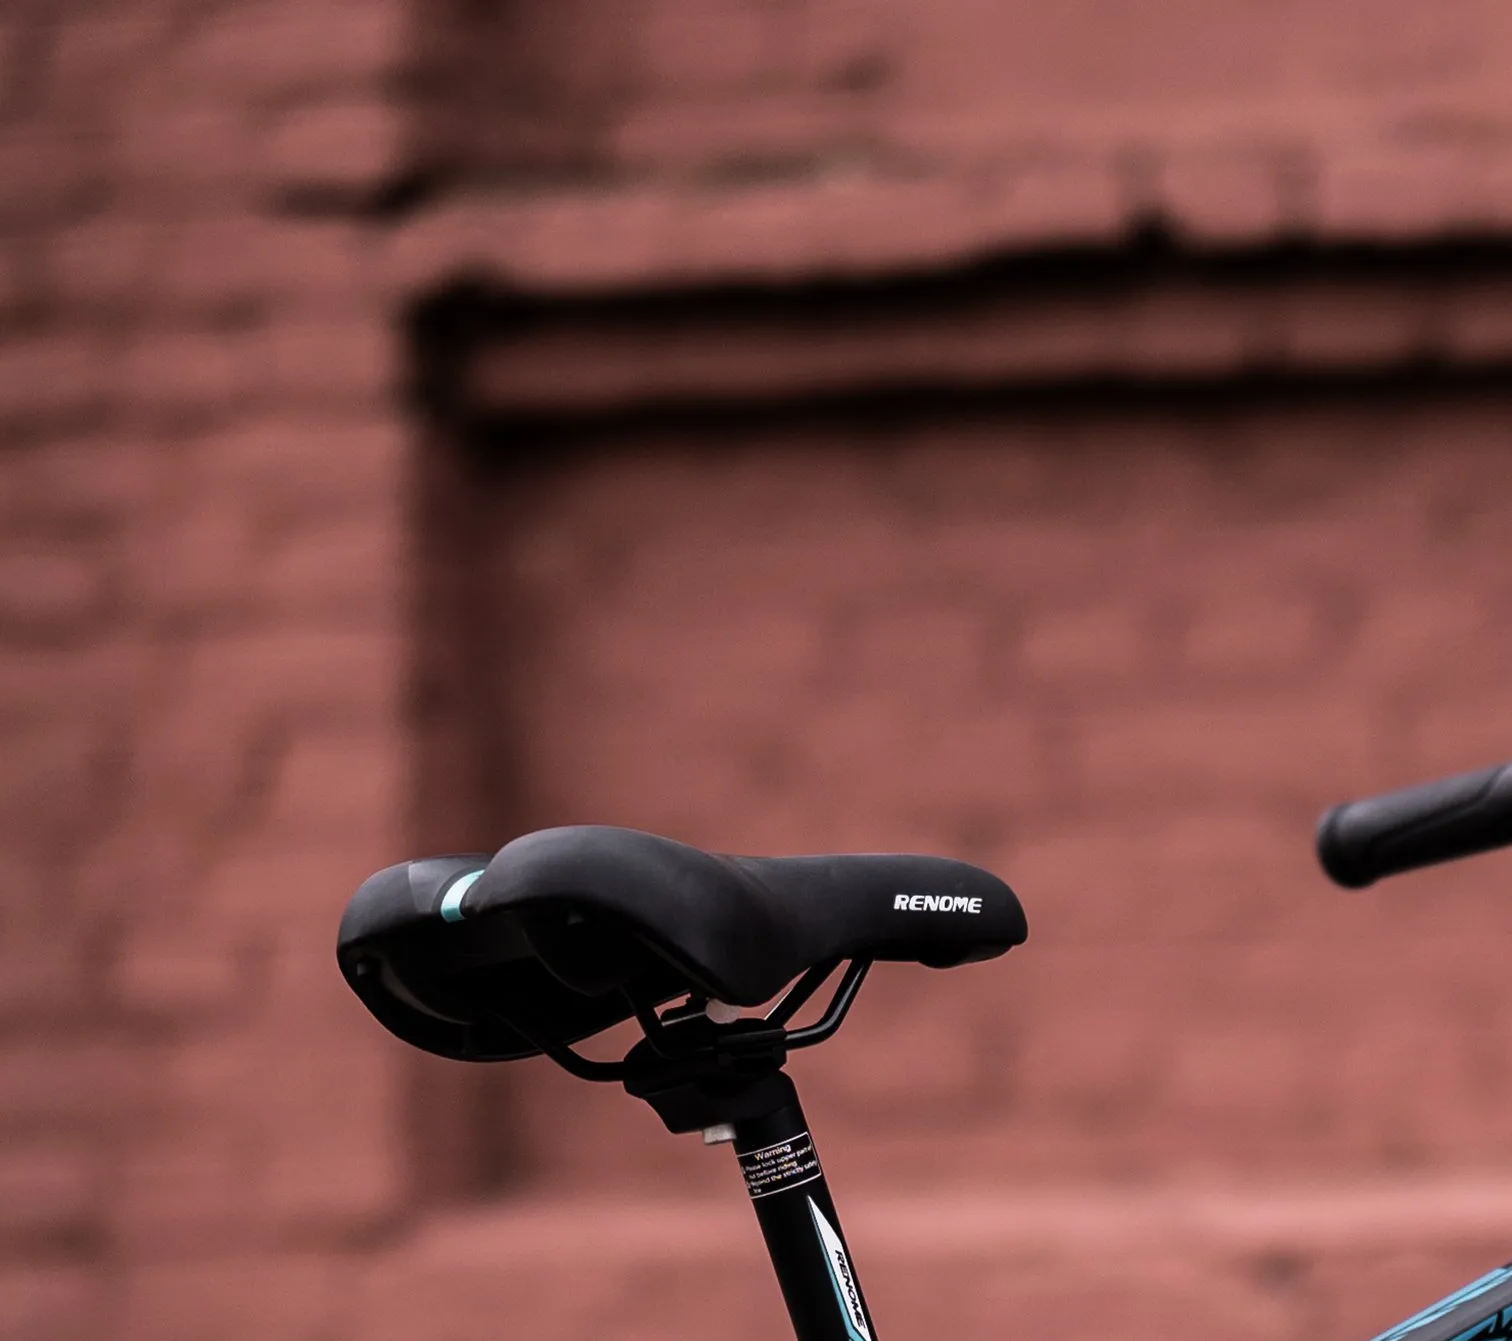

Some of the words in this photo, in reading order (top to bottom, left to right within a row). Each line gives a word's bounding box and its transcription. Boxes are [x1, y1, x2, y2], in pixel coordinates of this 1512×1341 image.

[893, 894, 983, 914] RENOME
[754, 1144, 792, 1160] Warning
[834, 1249, 867, 1330] RENOME
